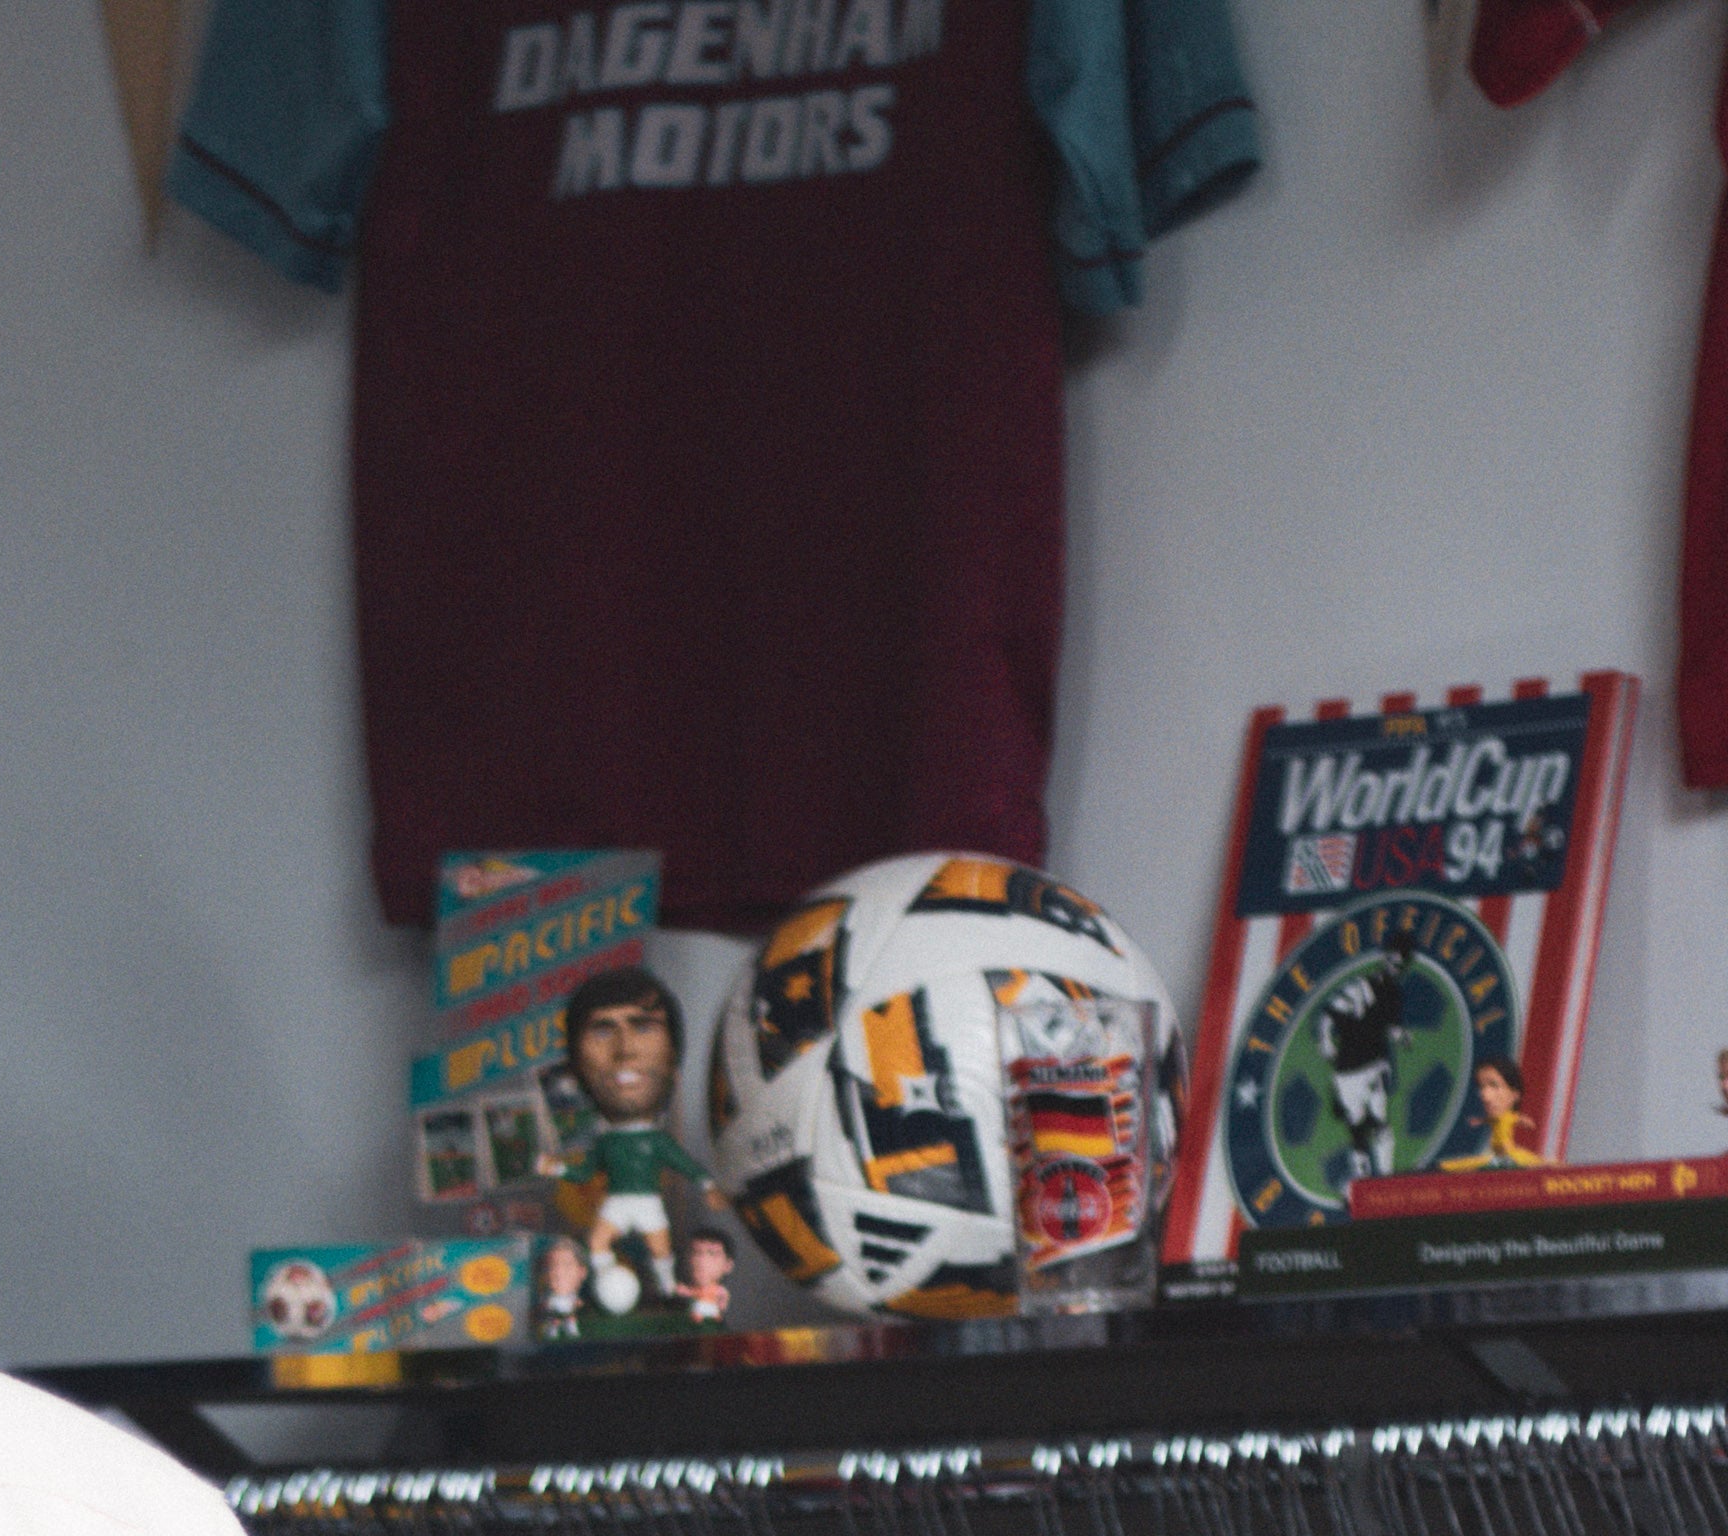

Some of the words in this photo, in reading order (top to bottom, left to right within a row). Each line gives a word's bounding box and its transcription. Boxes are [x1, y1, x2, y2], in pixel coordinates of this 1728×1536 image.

[554, 83, 896, 199] MOTORS
[1353, 824, 1447, 889] USA
[1445, 819, 1504, 882] 94
[448, 885, 645, 996] PACIFIC
[1247, 964, 1314, 1052] THE
[1343, 904, 1505, 1034] OFFICIAL
[1255, 1250, 1344, 1273] FOOTBALL
[1419, 1242, 1501, 1266] Designing
[1504, 1239, 1530, 1260] the
[1532, 1234, 1610, 1257] Beautiful
[1614, 1231, 1665, 1251] Game
